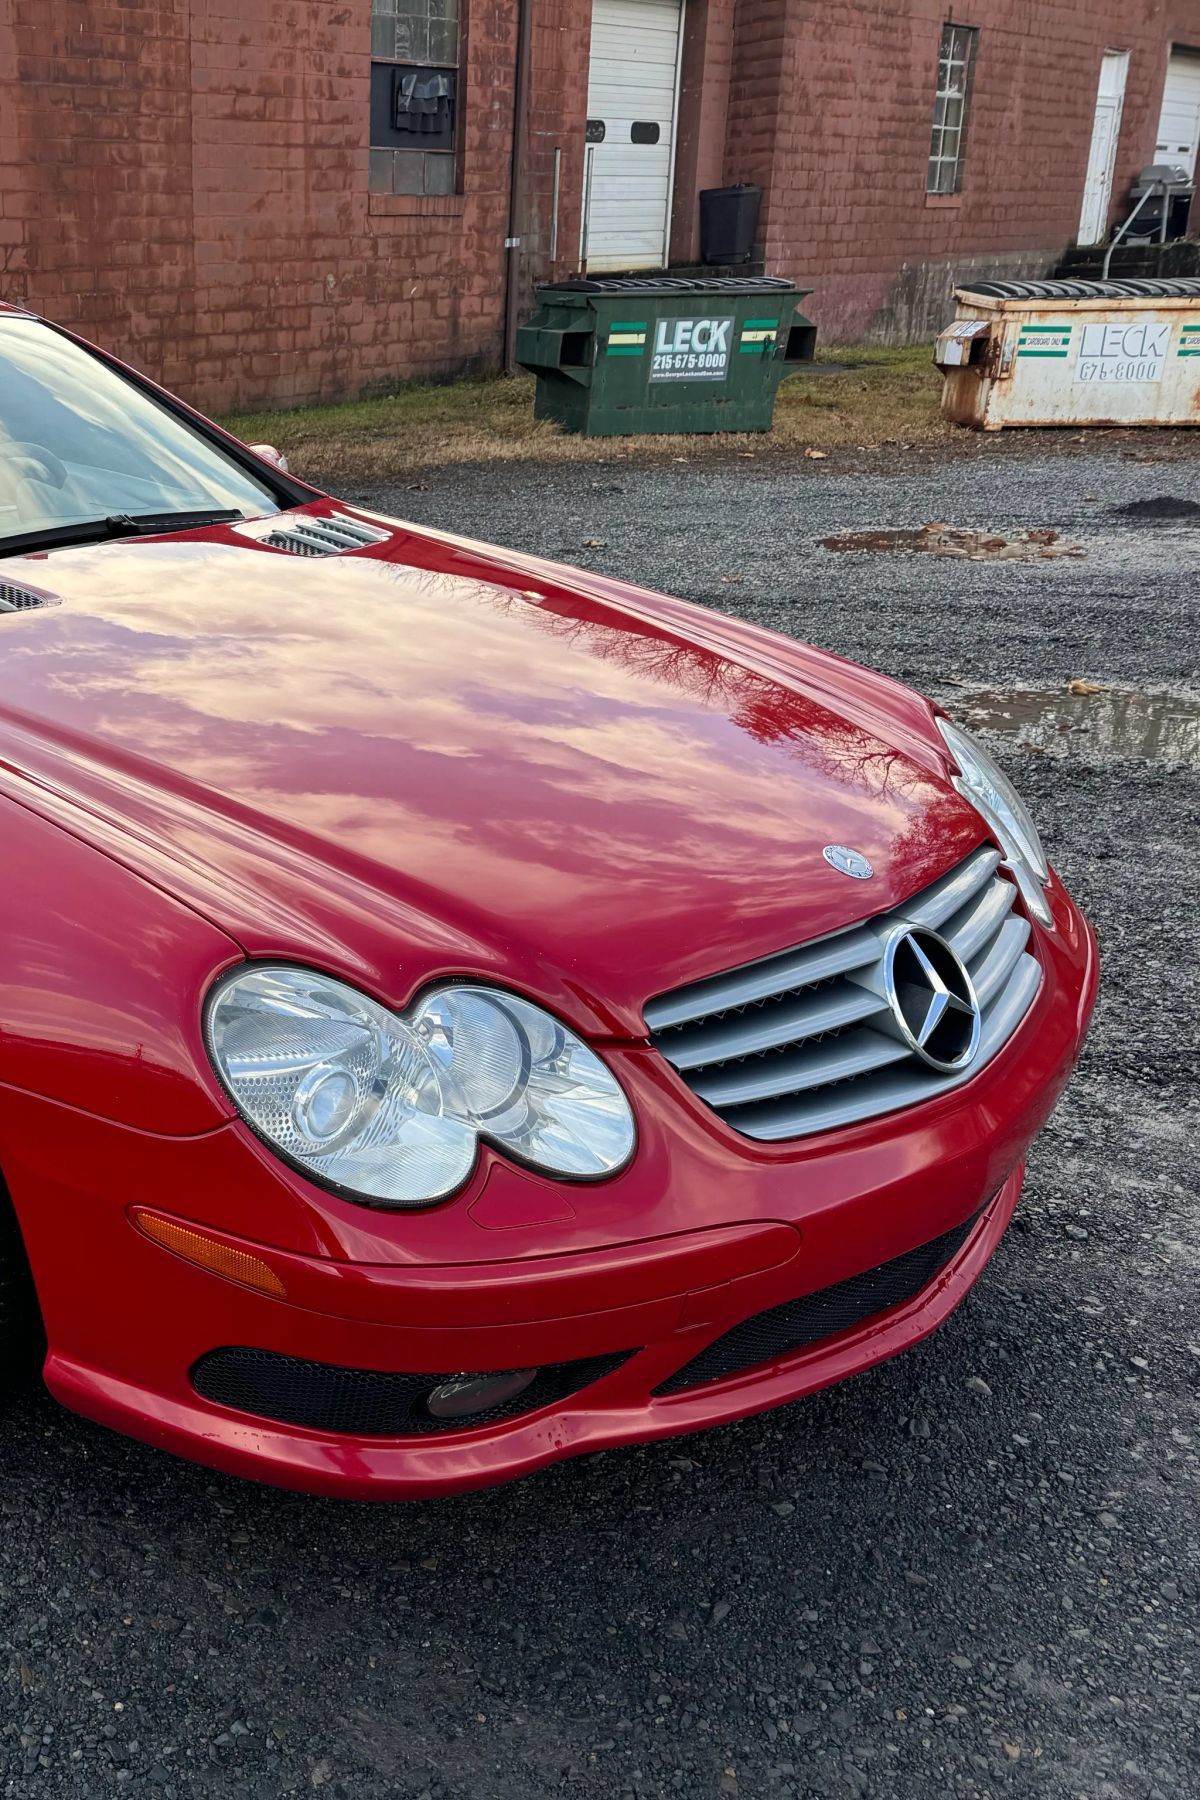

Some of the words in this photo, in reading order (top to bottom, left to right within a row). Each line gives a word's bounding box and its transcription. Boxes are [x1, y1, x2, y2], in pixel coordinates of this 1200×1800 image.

[656, 320, 731, 353] LECK
[1027, 337, 1050, 345] CARDBOARD
[1051, 337, 1061, 345] ONLY
[1079, 325, 1168, 357] LECK
